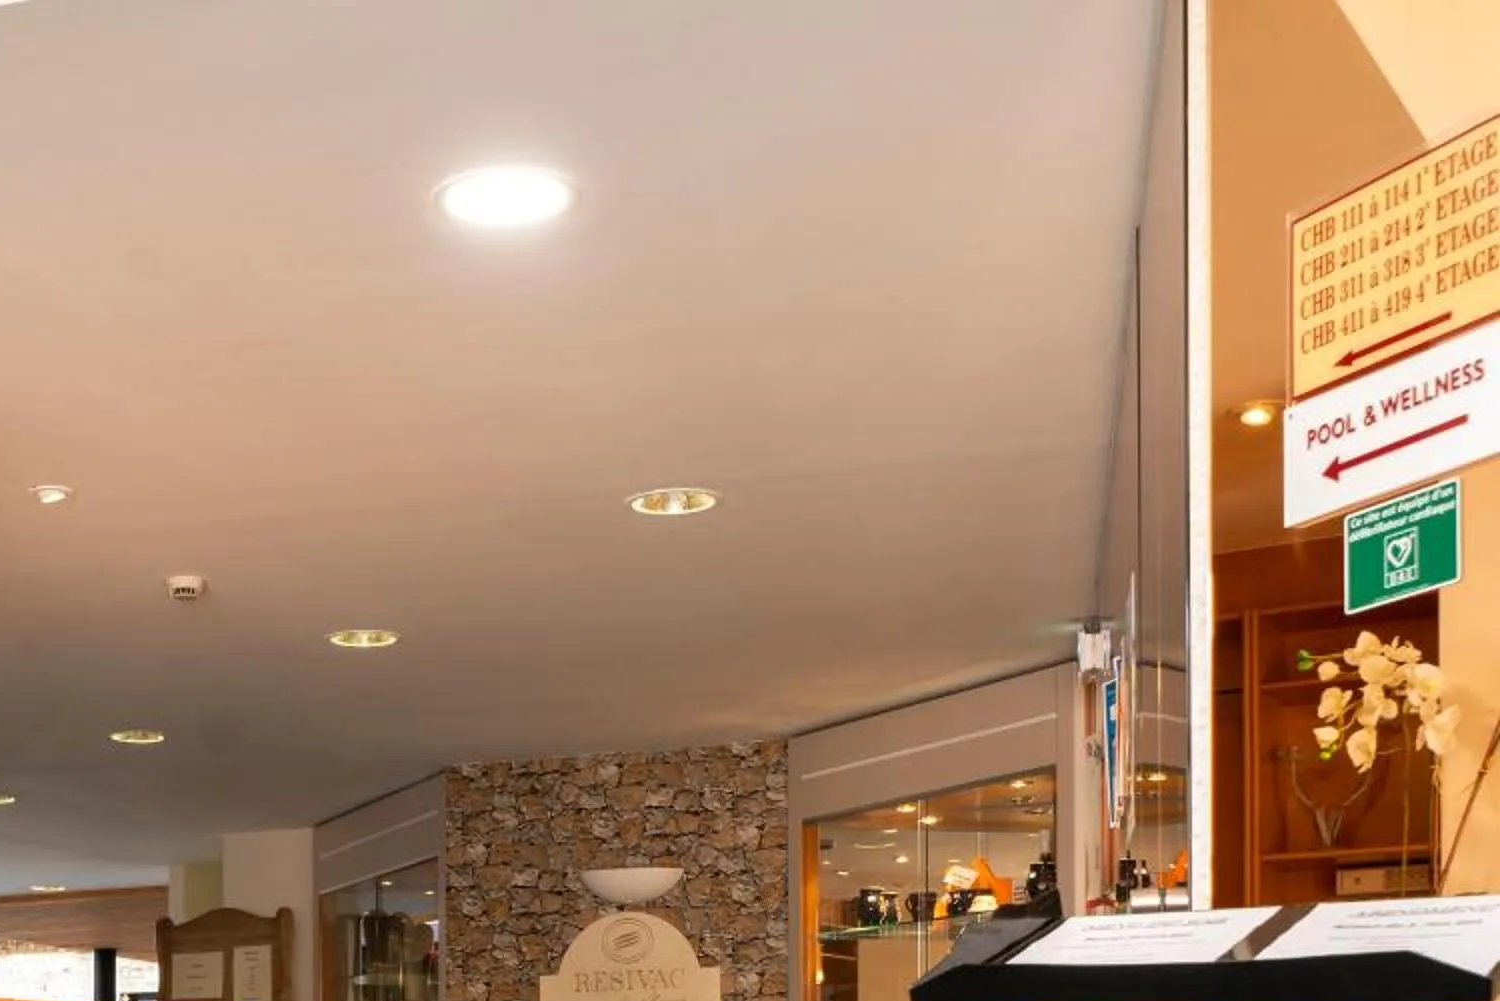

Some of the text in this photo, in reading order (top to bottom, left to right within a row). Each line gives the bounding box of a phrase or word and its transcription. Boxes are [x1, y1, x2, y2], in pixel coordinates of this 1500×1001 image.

[1301, 216, 1336, 252] CHB
[1342, 202, 1363, 233] 111
[1369, 194, 1379, 218] à
[1384, 179, 1410, 211] 114
[1435, 131, 1498, 187] ETAGE
[1301, 250, 1336, 287] CHB
[1340, 236, 1365, 268] 211
[1369, 229, 1379, 254] à
[1383, 214, 1411, 247] 214
[1436, 168, 1500, 221] ETAGE
[1300, 284, 1336, 321] CHB
[1339, 270, 1364, 303] 311
[1369, 264, 1379, 289] à
[1383, 250, 1411, 283] 318
[1436, 206, 1500, 259] ETAGE
[1301, 319, 1336, 355] CHB
[1340, 306, 1365, 337] 411
[1369, 301, 1379, 324] à
[1384, 286, 1411, 318] 419
[1436, 244, 1500, 295] ETAGE
[1307, 358, 1486, 450] POOL & WELLNESS
[573, 967, 685, 993] RESIVAC
